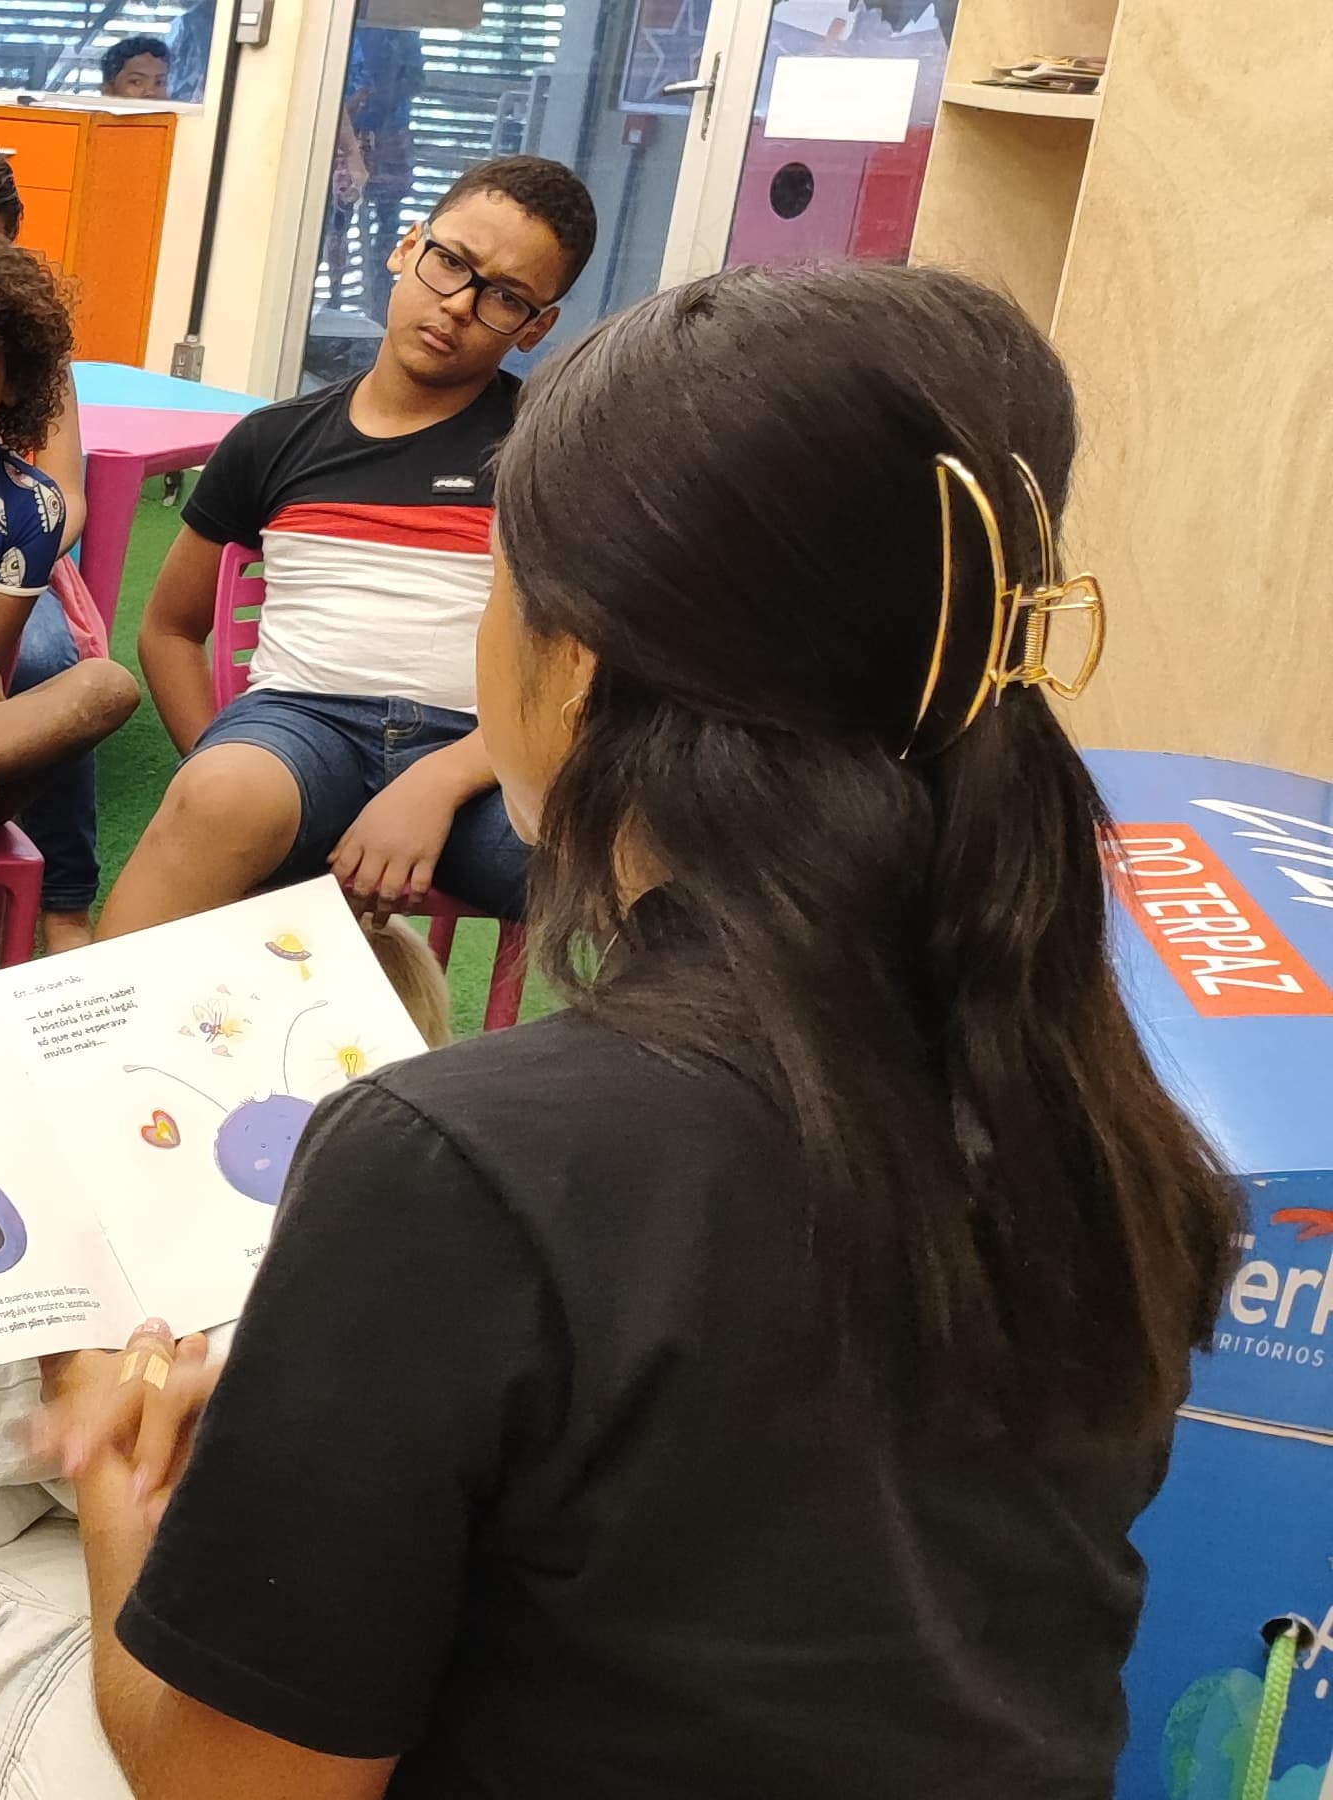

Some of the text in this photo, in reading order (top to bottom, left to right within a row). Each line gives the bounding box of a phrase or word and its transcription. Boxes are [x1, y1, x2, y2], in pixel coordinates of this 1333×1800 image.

[1134, 882, 1305, 996] TERPAZ
[51, 1033, 69, 1045] que
[1212, 1331, 1326, 1368] RITÓRIOS
